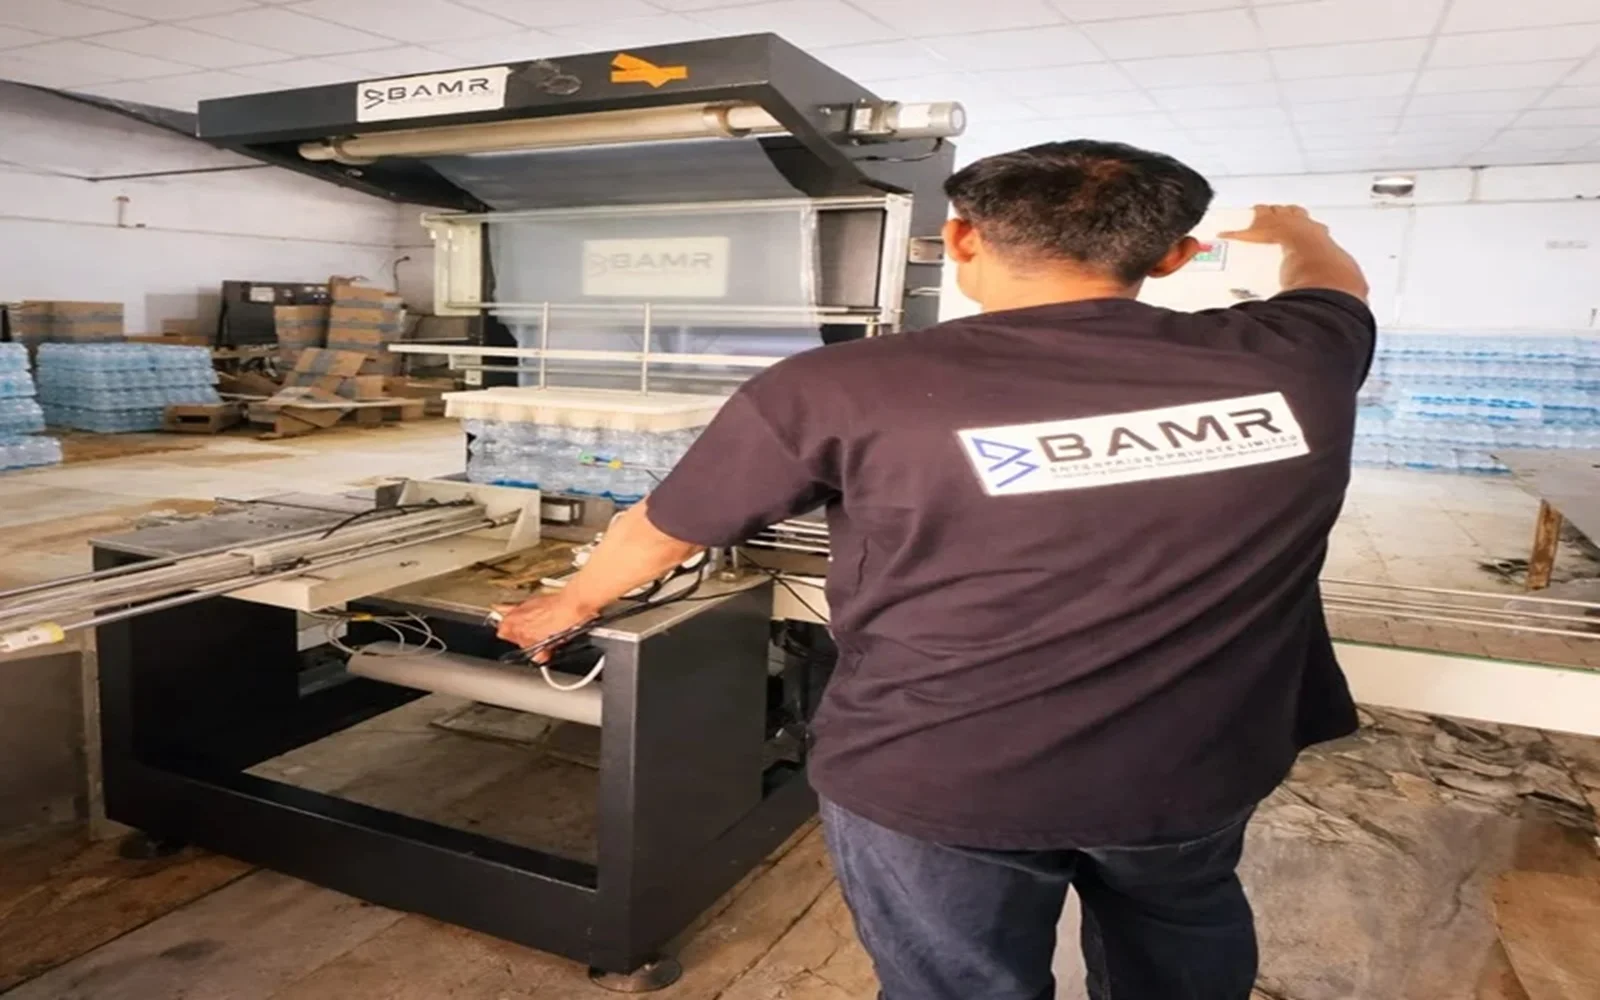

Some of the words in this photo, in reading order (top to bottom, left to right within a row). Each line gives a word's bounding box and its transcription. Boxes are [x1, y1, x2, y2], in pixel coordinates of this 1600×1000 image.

[387, 78, 490, 101] BAMR
[610, 251, 713, 270] BAMR
[1036, 407, 1282, 463] BAMR
